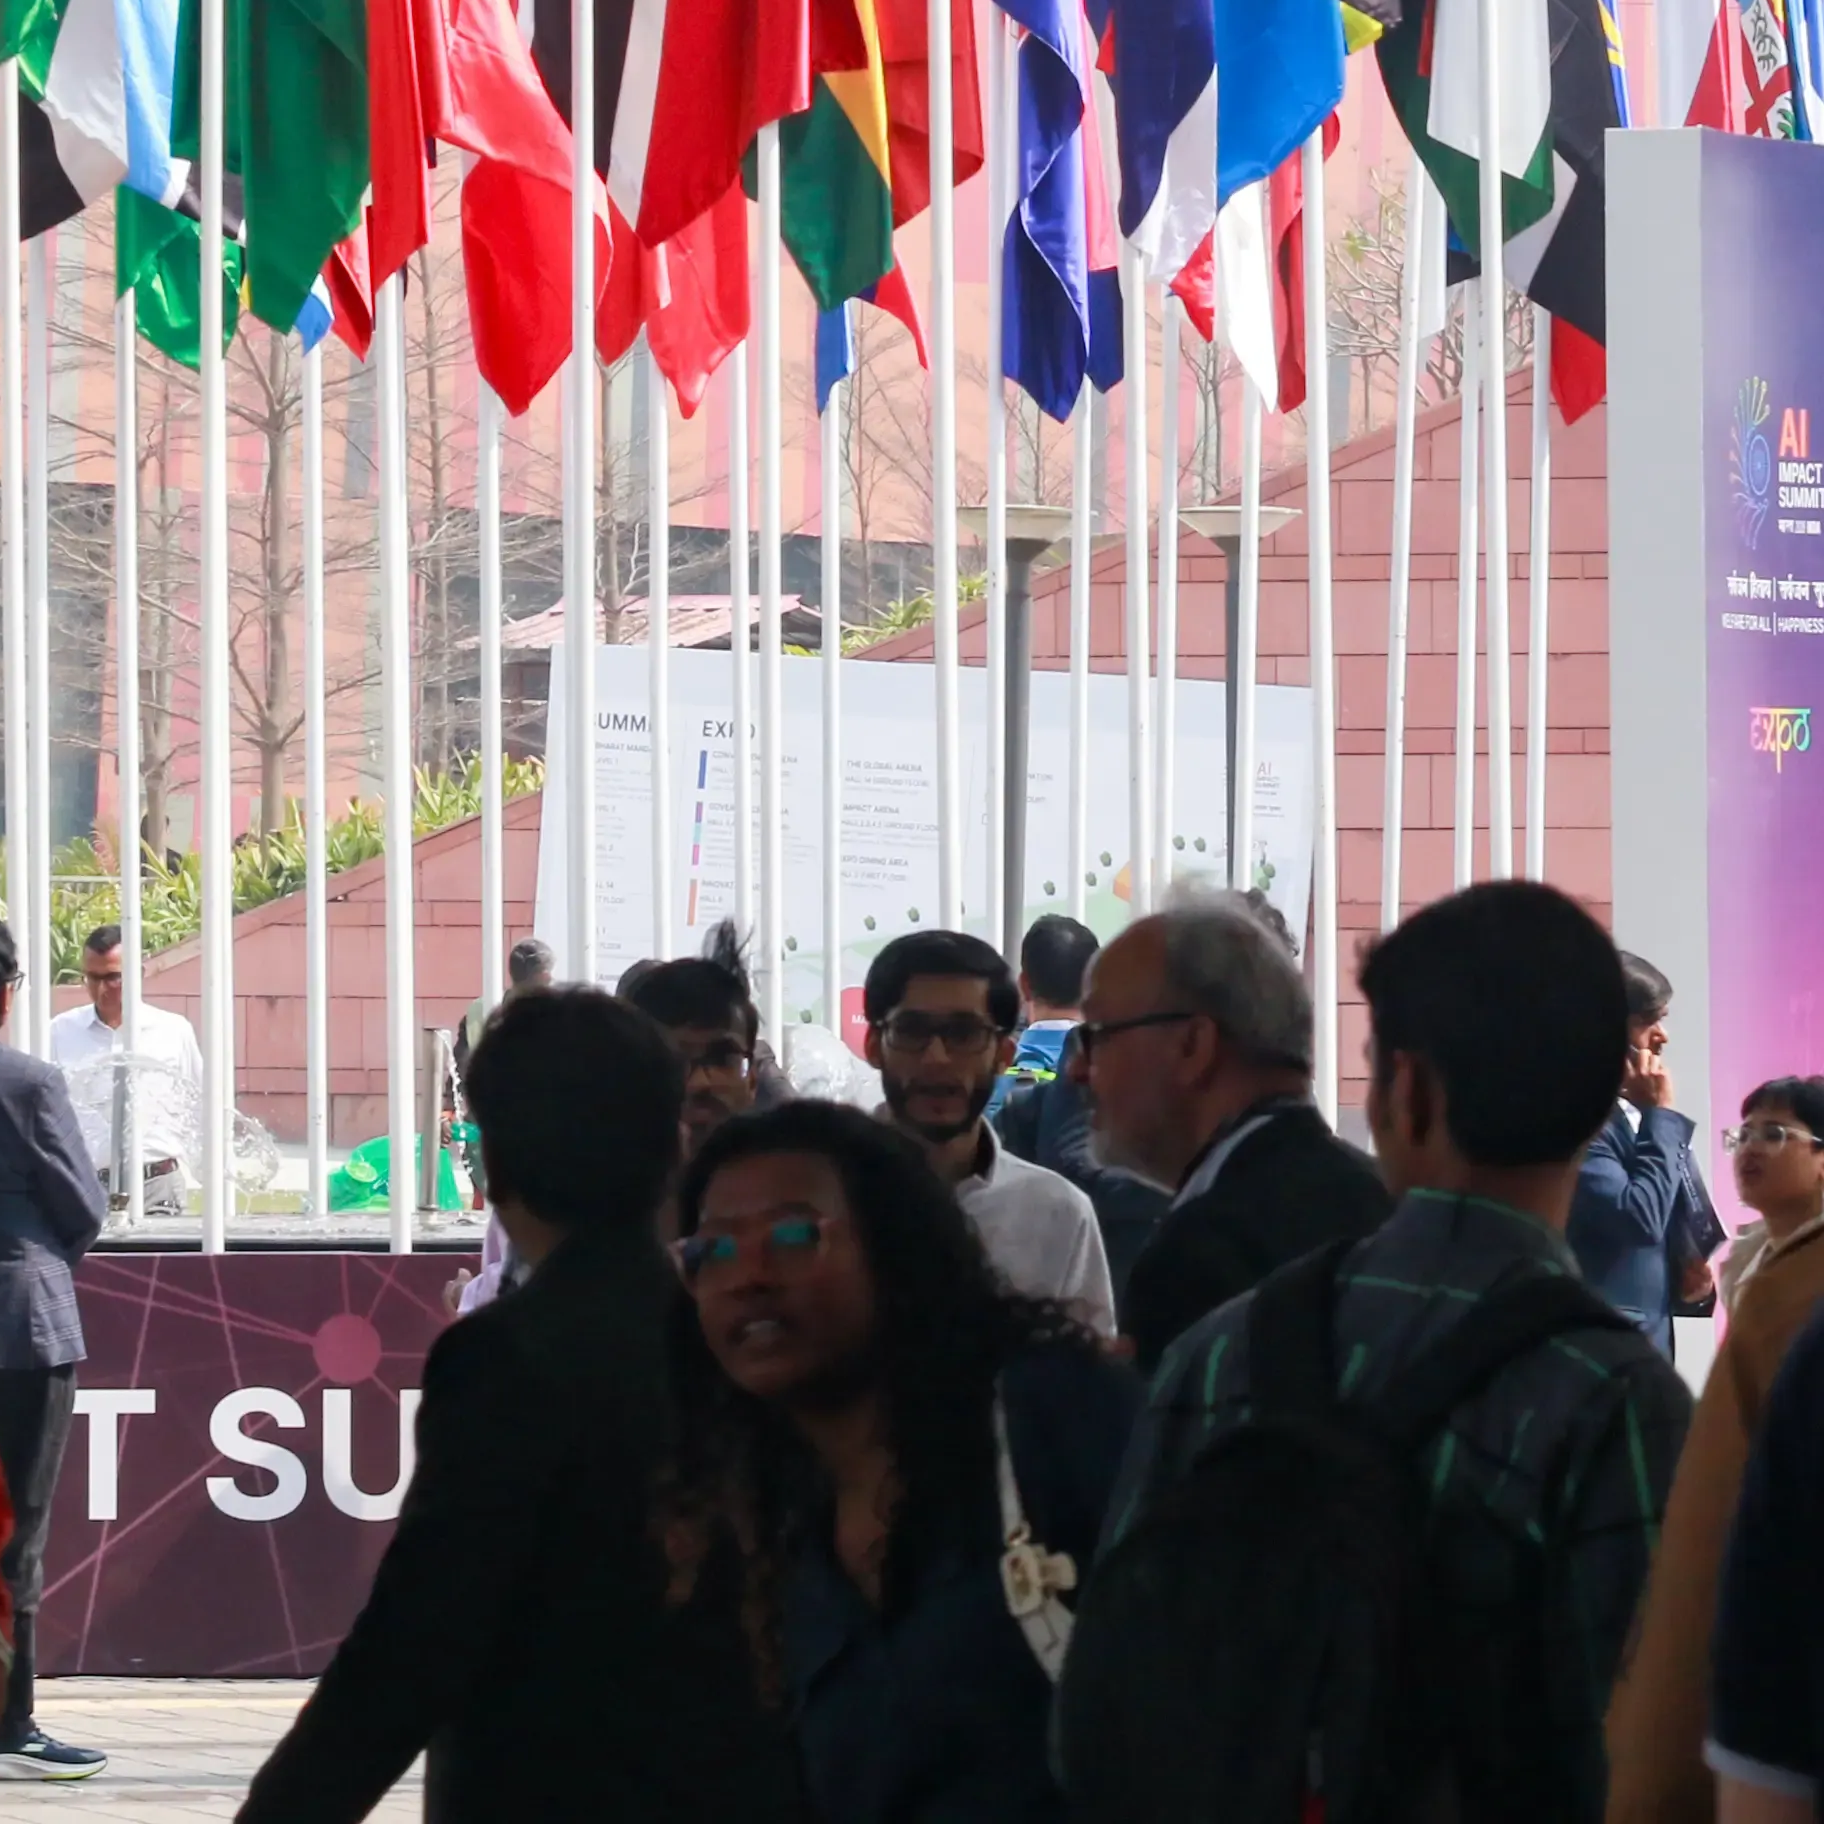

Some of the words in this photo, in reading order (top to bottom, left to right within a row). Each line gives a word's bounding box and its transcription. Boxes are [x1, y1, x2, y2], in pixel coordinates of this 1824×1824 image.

[1779, 407, 1808, 458] AI
[1778, 461, 1824, 484] IMPACT
[1778, 617, 1824, 634] HAPPINESS
[594, 712, 653, 733] UMM
[702, 720, 756, 739] EX
[846, 760, 861, 768] THE
[863, 761, 894, 771] GLOBAL
[1257, 761, 1272, 776] AI
[205, 1386, 423, 1522] SU
